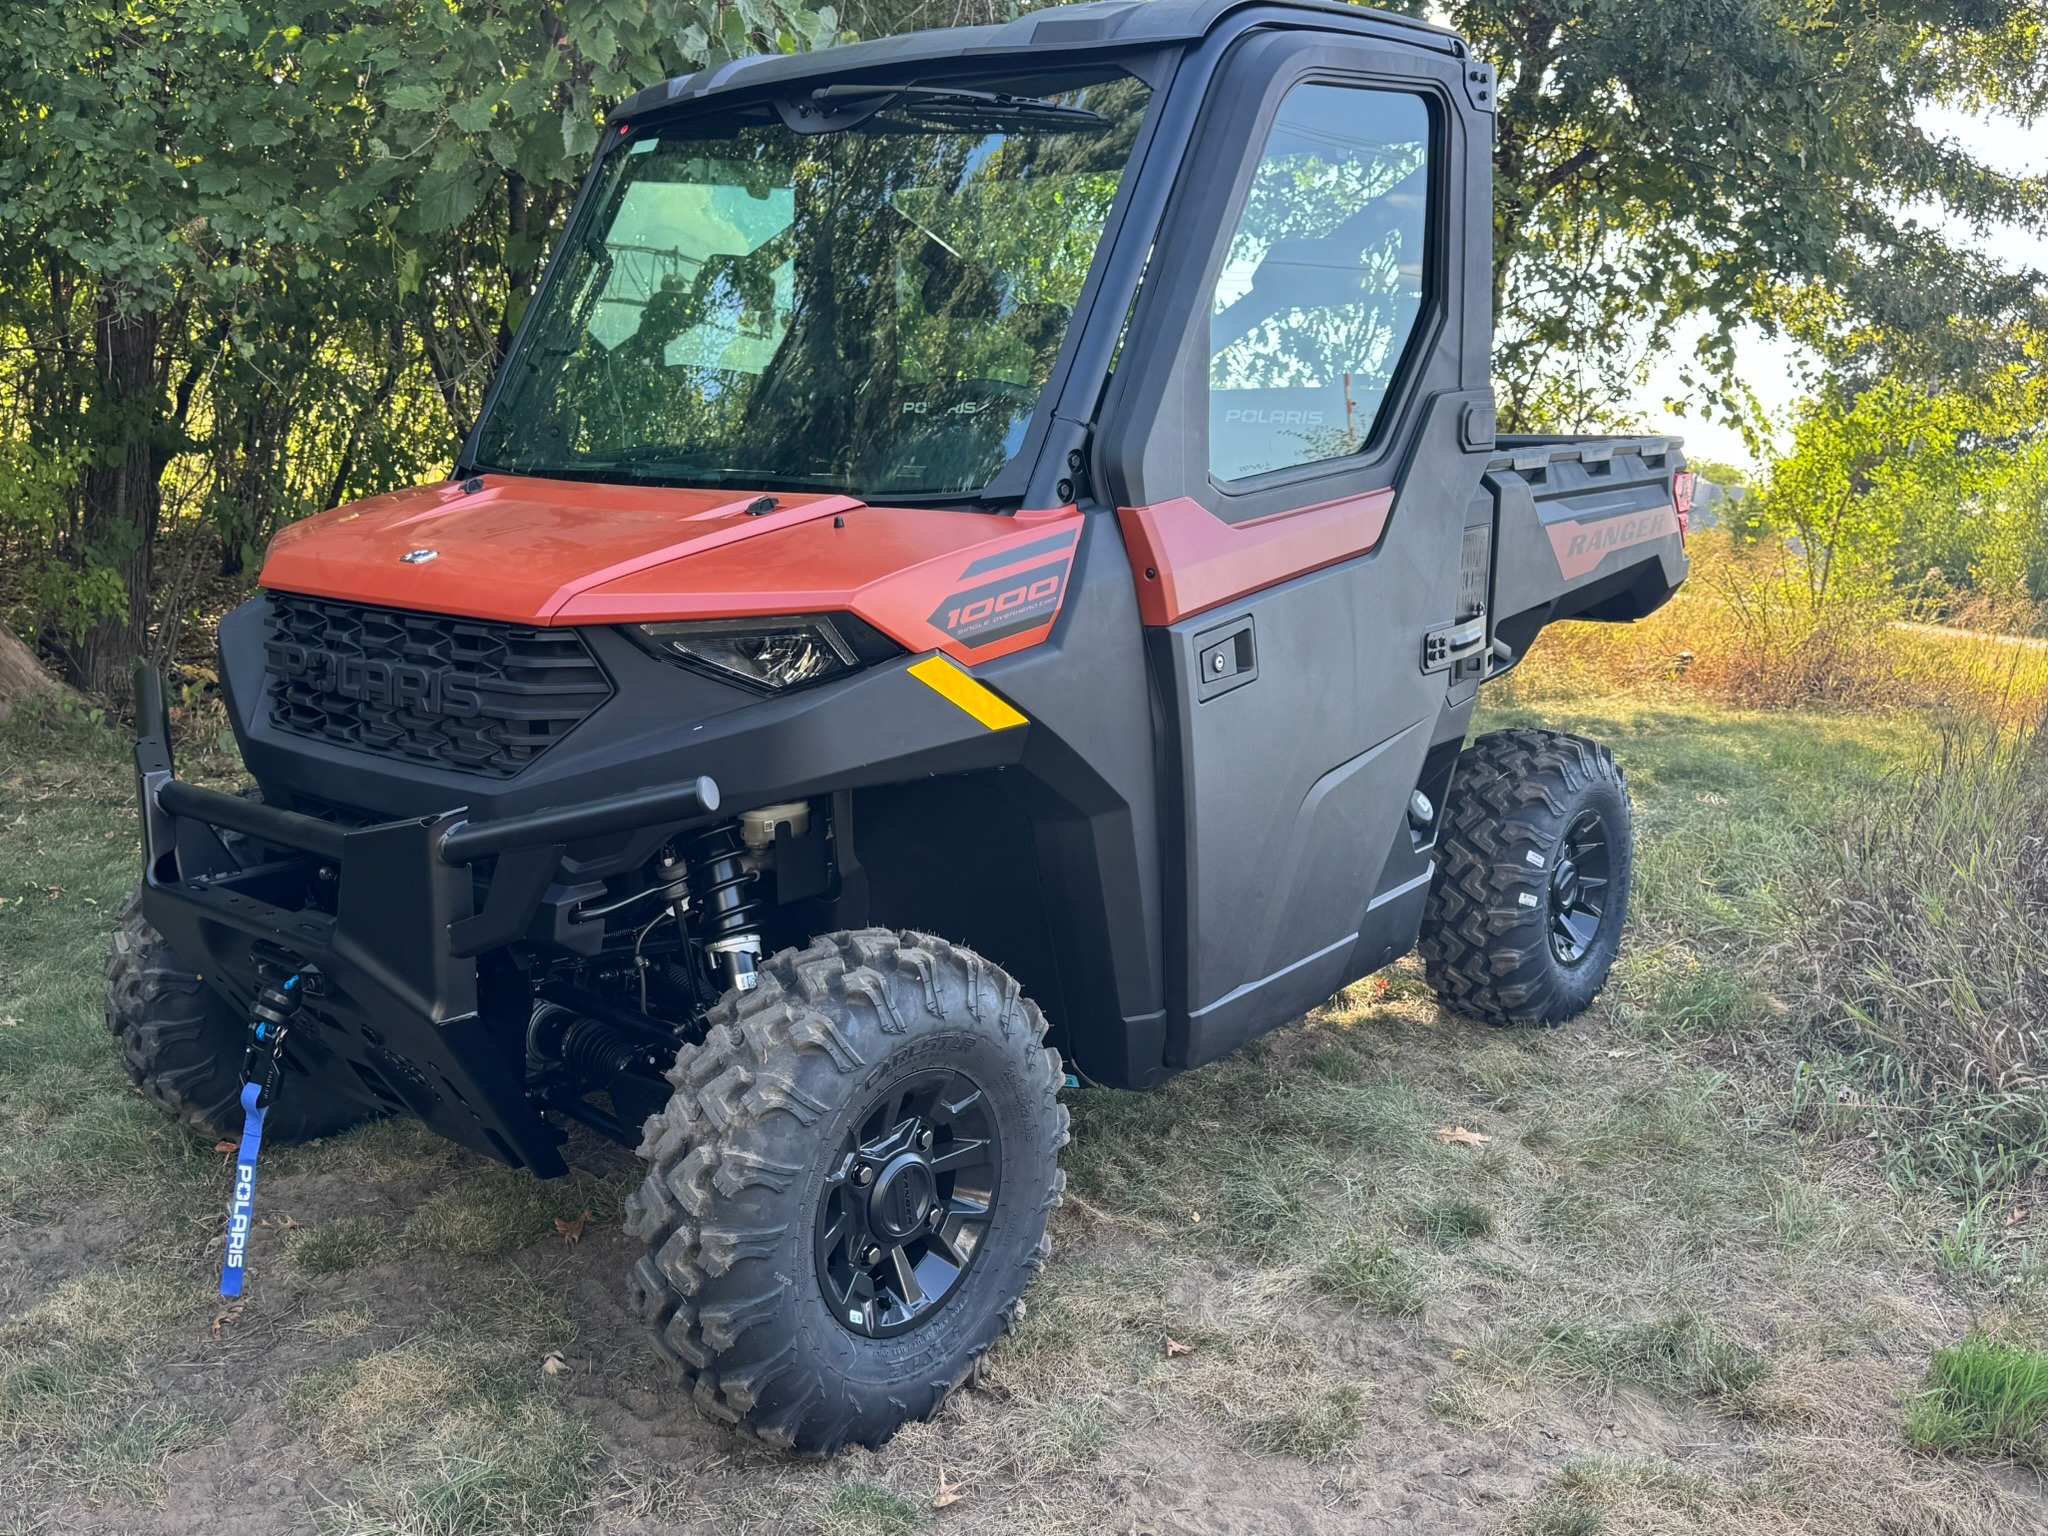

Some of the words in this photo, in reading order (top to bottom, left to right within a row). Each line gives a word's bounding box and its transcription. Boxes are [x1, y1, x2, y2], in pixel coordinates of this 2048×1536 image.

[1225, 409, 1324, 425] POLARIS
[1567, 513, 1666, 558] RANGER
[947, 575, 1059, 629] 1000
[957, 620, 990, 635] SINGLE
[993, 603, 1038, 623] OVERHEAD
[1039, 596, 1057, 607] CAM
[282, 645, 481, 718] POLARIS
[228, 1165, 252, 1268] POLARIS
[903, 1171, 913, 1226] RANGER
